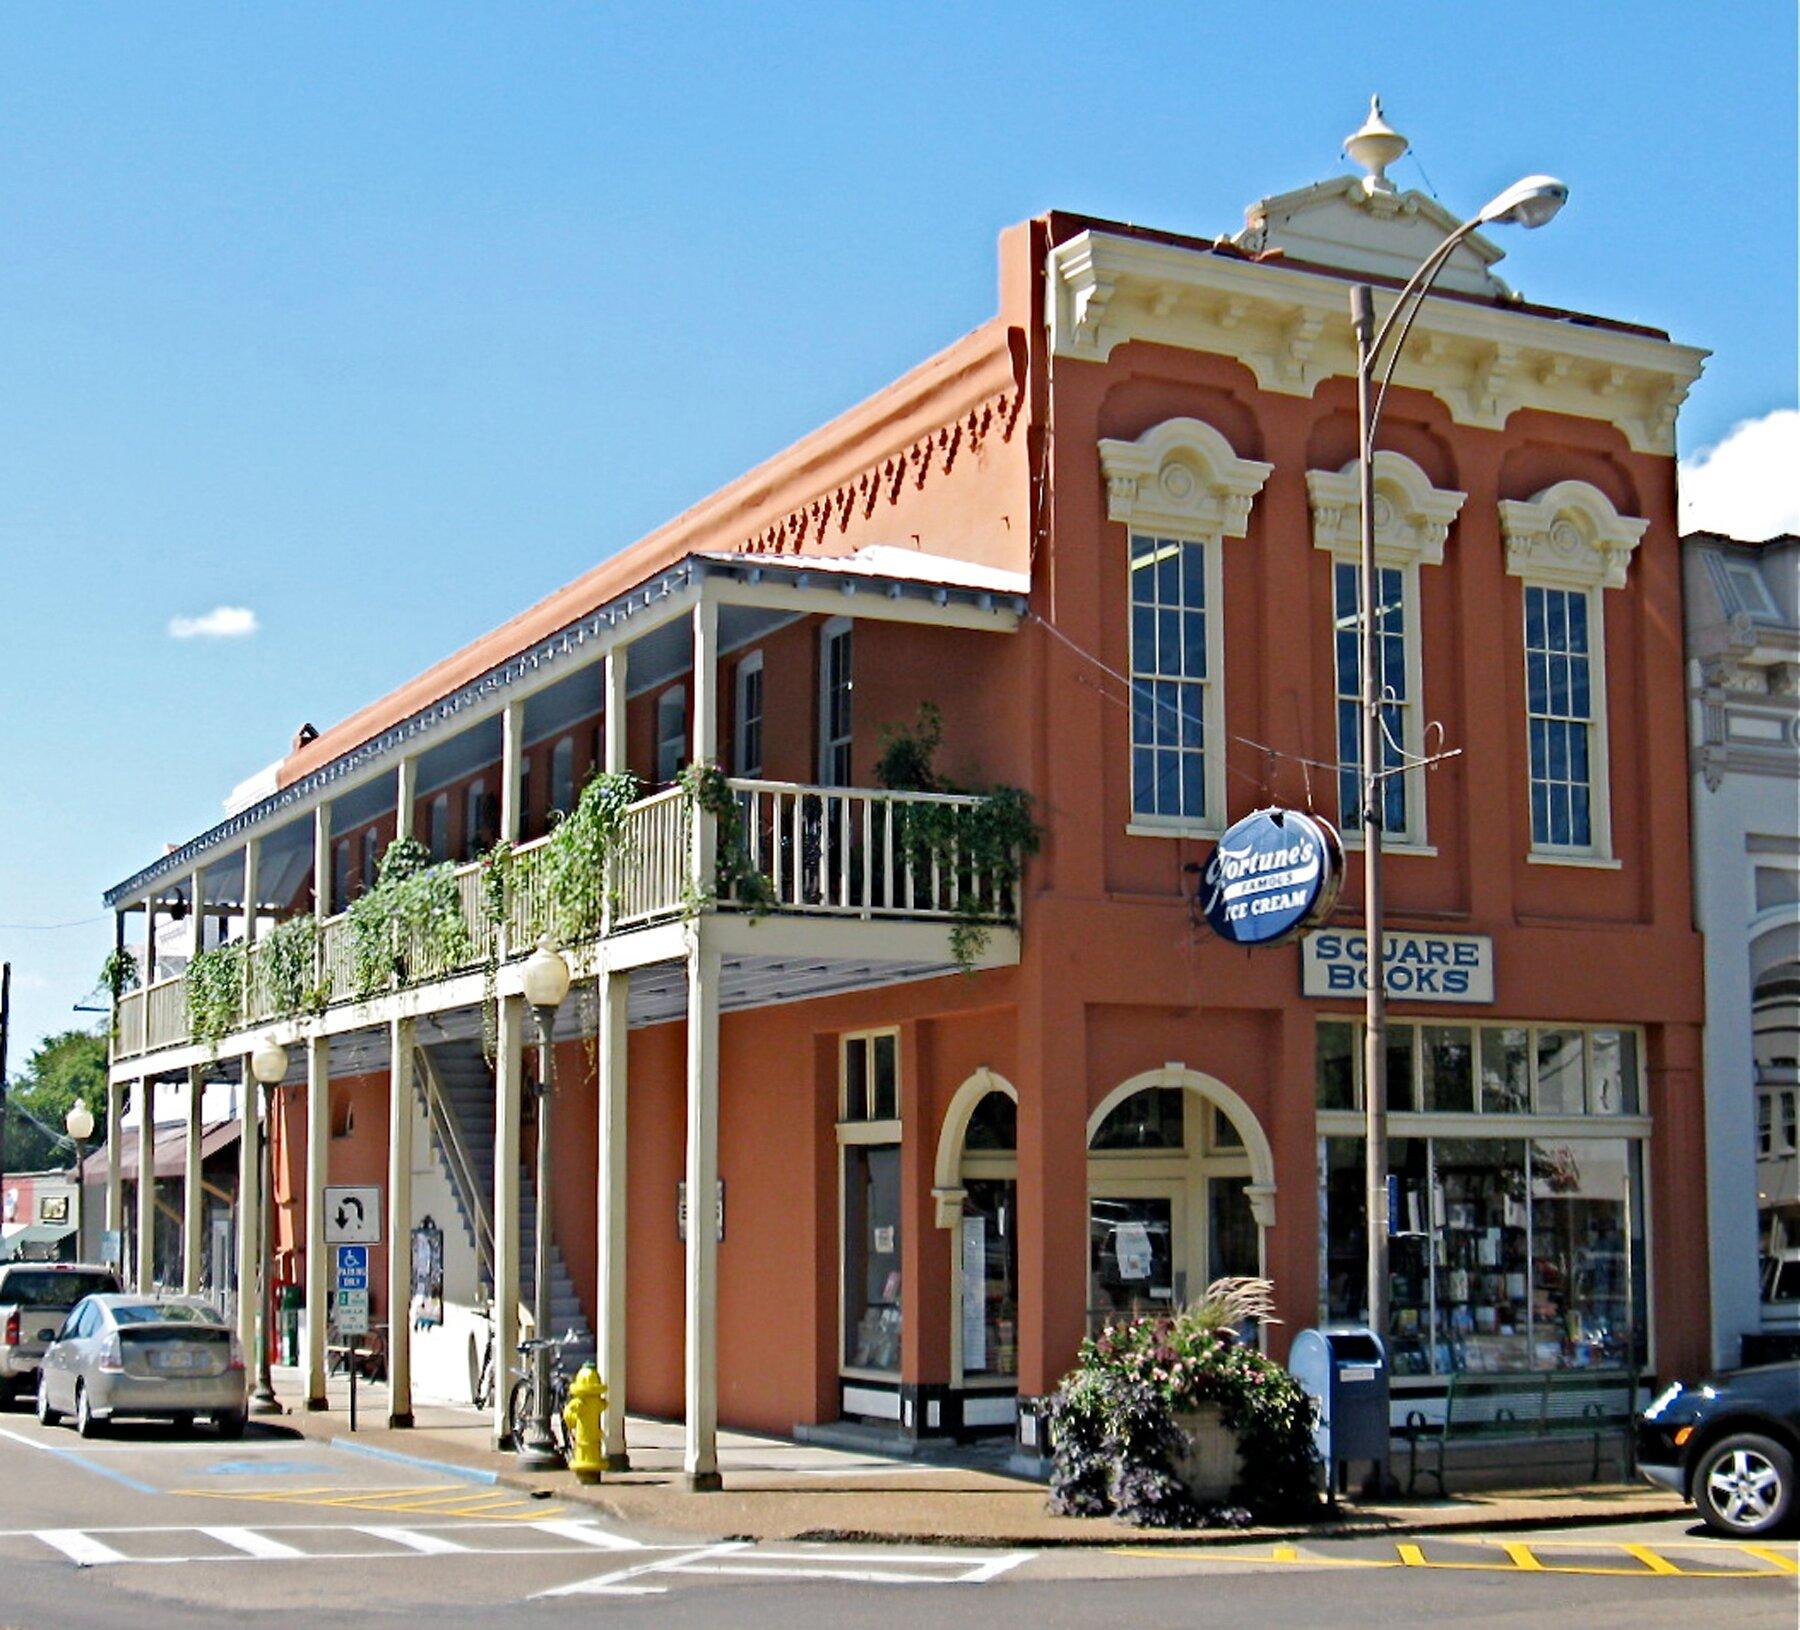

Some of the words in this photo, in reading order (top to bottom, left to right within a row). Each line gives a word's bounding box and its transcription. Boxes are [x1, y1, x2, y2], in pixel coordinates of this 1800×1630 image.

[1204, 837, 1313, 914] Fortune's
[1241, 872, 1293, 893] FAMOUS
[1225, 902, 1248, 921] ICE
[1251, 889, 1307, 915] CREAM
[1315, 934, 1480, 967] SQUARE
